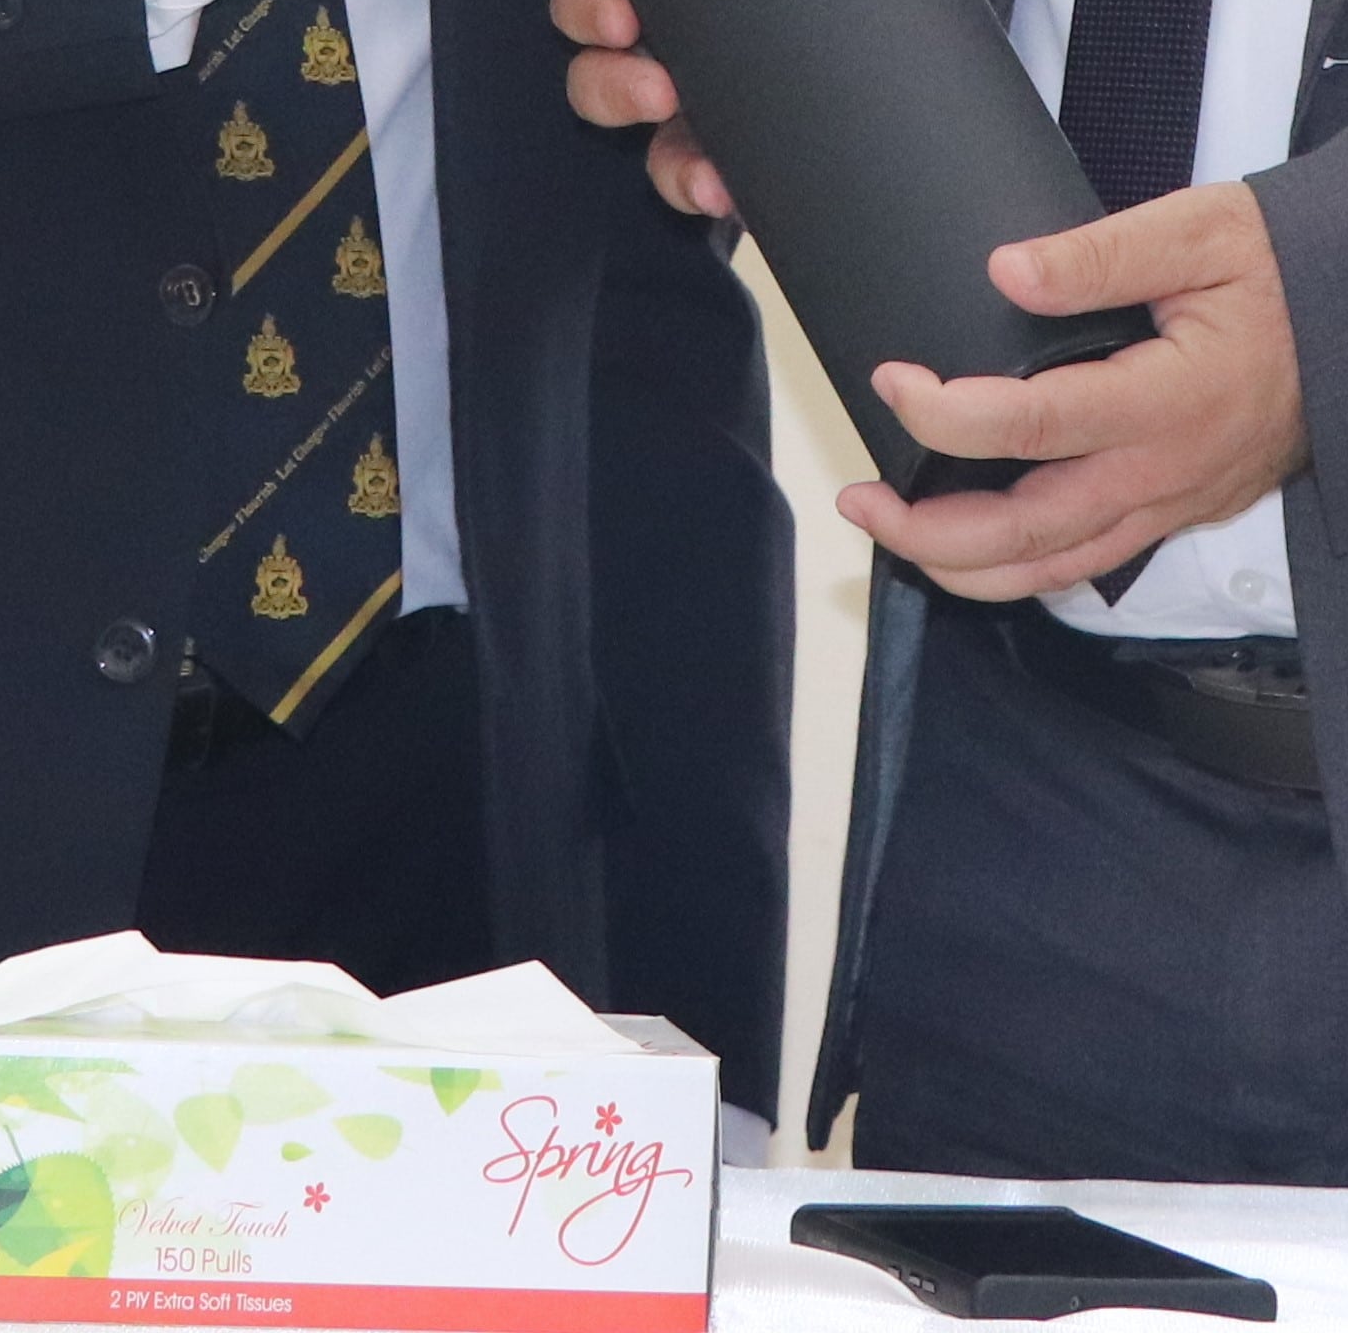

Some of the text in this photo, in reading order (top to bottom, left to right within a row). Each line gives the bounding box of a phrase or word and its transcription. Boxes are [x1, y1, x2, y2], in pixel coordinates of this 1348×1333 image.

[275, 458, 299, 481] Let
[482, 1094, 694, 1266] Spring
[118, 1196, 290, 1238] Velvet Touch
[155, 1246, 253, 1275] 150 Pulls
[109, 1290, 122, 1310] 2
[153, 1291, 195, 1311] Extra
[198, 1292, 231, 1312] Soft
[236, 1292, 293, 1314] Tissues
